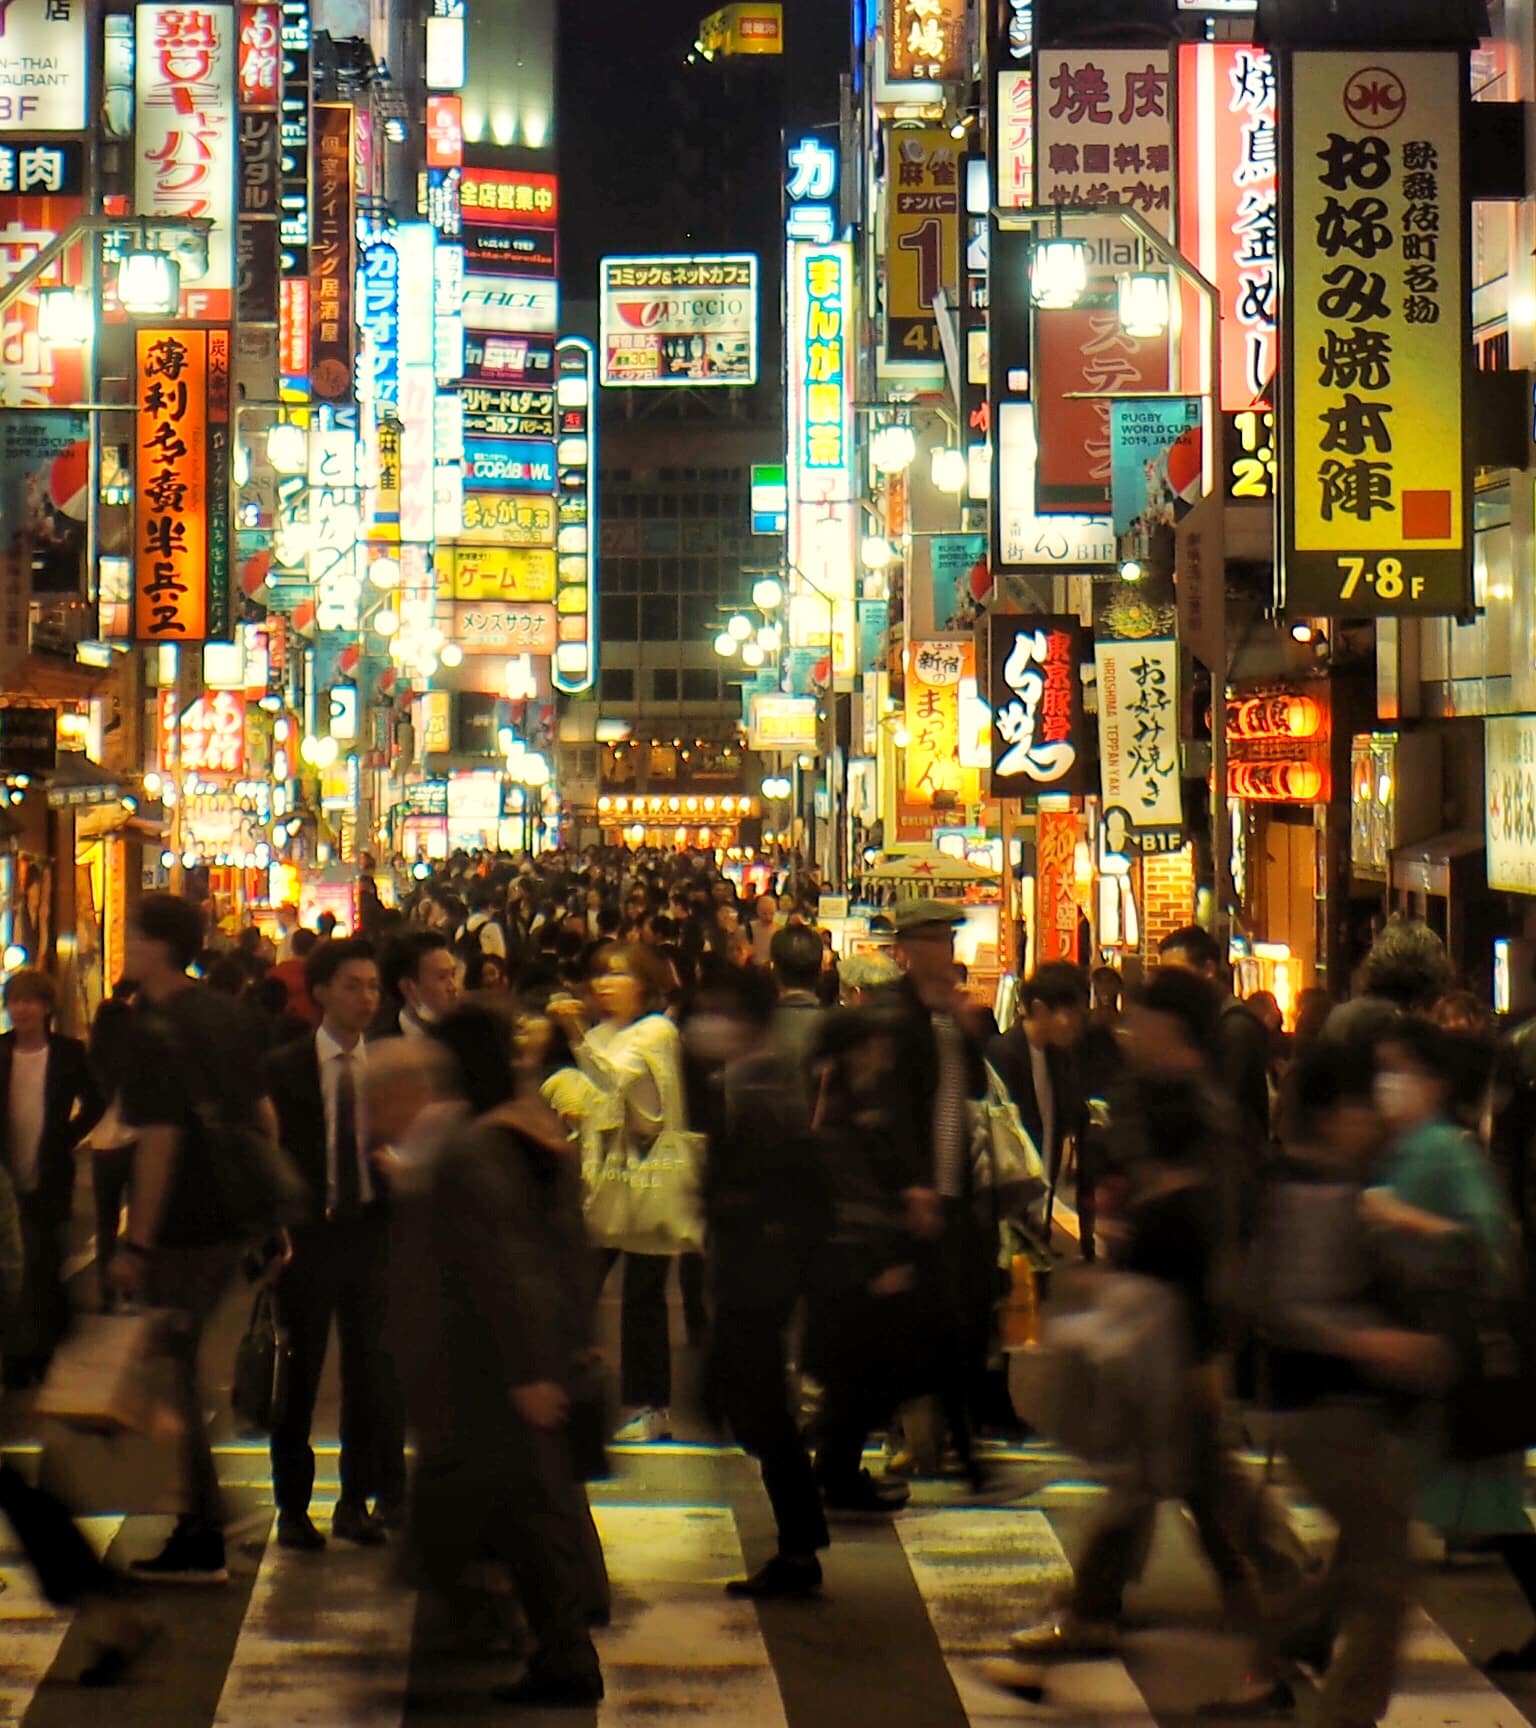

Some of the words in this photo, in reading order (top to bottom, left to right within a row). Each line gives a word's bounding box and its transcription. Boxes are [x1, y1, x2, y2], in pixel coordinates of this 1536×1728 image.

[913, 65, 941, 77] 5F
[899, 162, 956, 186] 麻雀
[460, 181, 553, 213] 全店営業中
[902, 197, 956, 209] ナンバー
[1401, 141, 1440, 325] 歌舞伎町名物
[609, 266, 749, 285] コミック&ネットカフェ
[1317, 131, 1394, 522] お好み焼本陣
[1121, 414, 1161, 423] RUGBY
[1121, 425, 1165, 434] WORLD
[1167, 425, 1192, 434] CUP
[1153, 437, 1192, 445] JAPAN
[464, 498, 550, 529] まんが喫茶
[459, 565, 517, 589] ゲーム
[464, 613, 545, 633] メンズサウナ
[1104, 658, 1118, 716] HIROSHIMA
[1126, 656, 1174, 806] お好み焼き
[1107, 725, 1119, 765] TEPPAN
[1142, 833, 1180, 851] B1F
